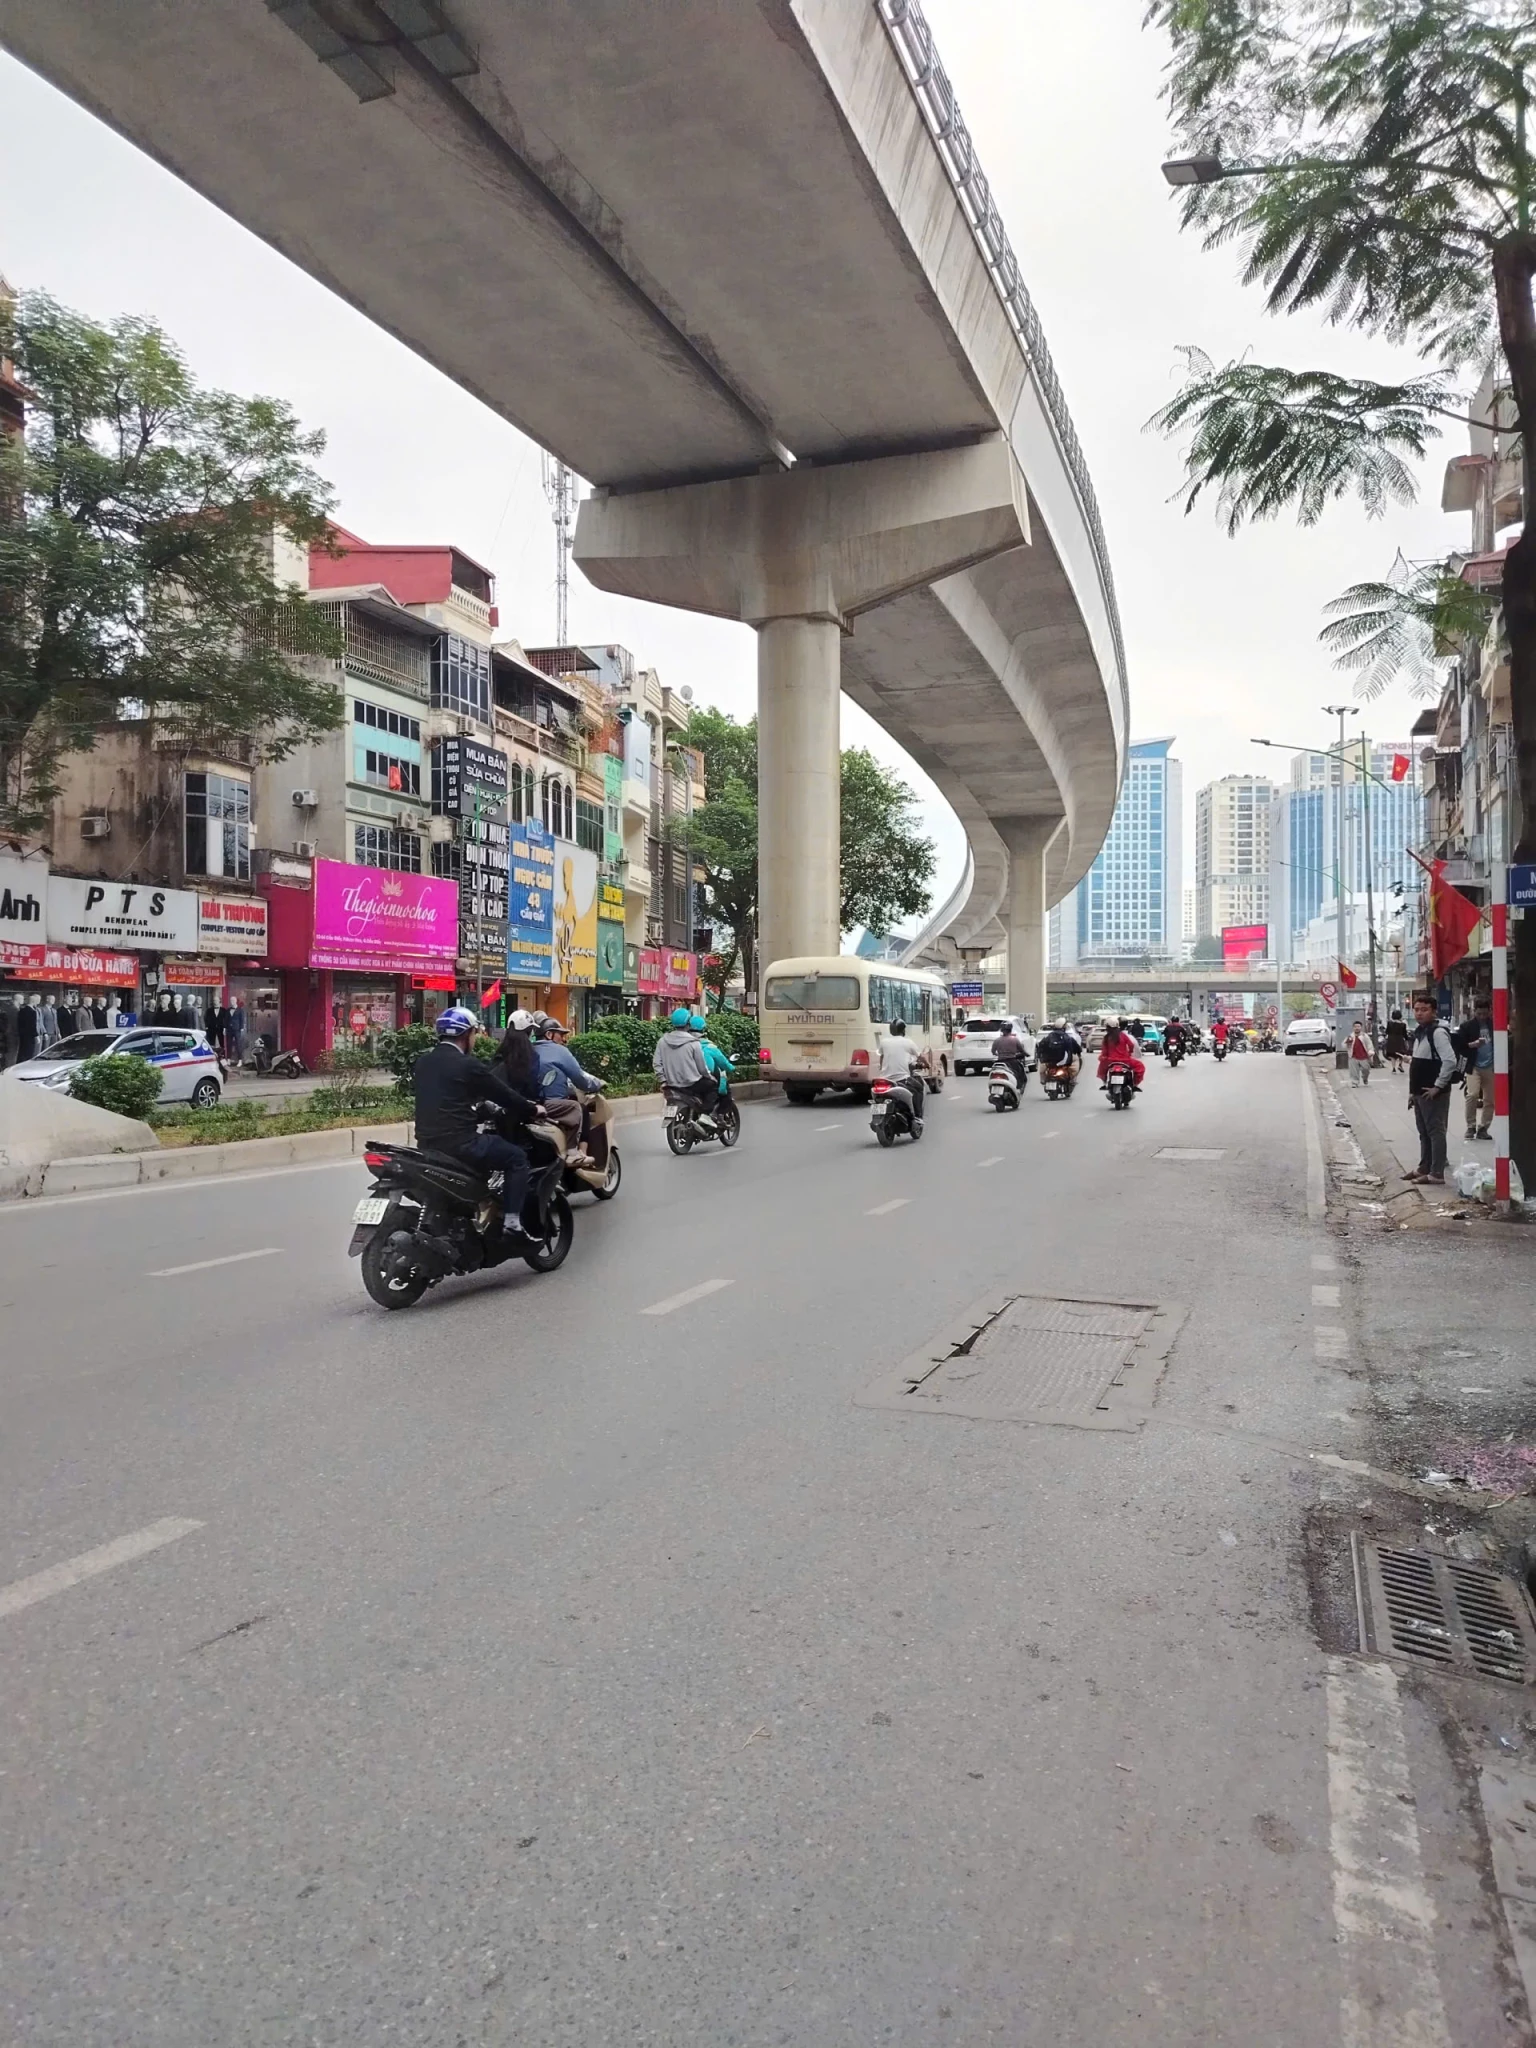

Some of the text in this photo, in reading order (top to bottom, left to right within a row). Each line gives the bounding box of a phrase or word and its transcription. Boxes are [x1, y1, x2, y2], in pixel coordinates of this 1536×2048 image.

[466, 747, 507, 771] MUA BÁN
[466, 764, 506, 787] SỬA CHỮA
[489, 825, 506, 845] MUA
[1, 889, 40, 922] Anh
[487, 899, 503, 919] CAO
[487, 932, 506, 946] BÁN
[788, 1015, 835, 1024] HYUNDAI
